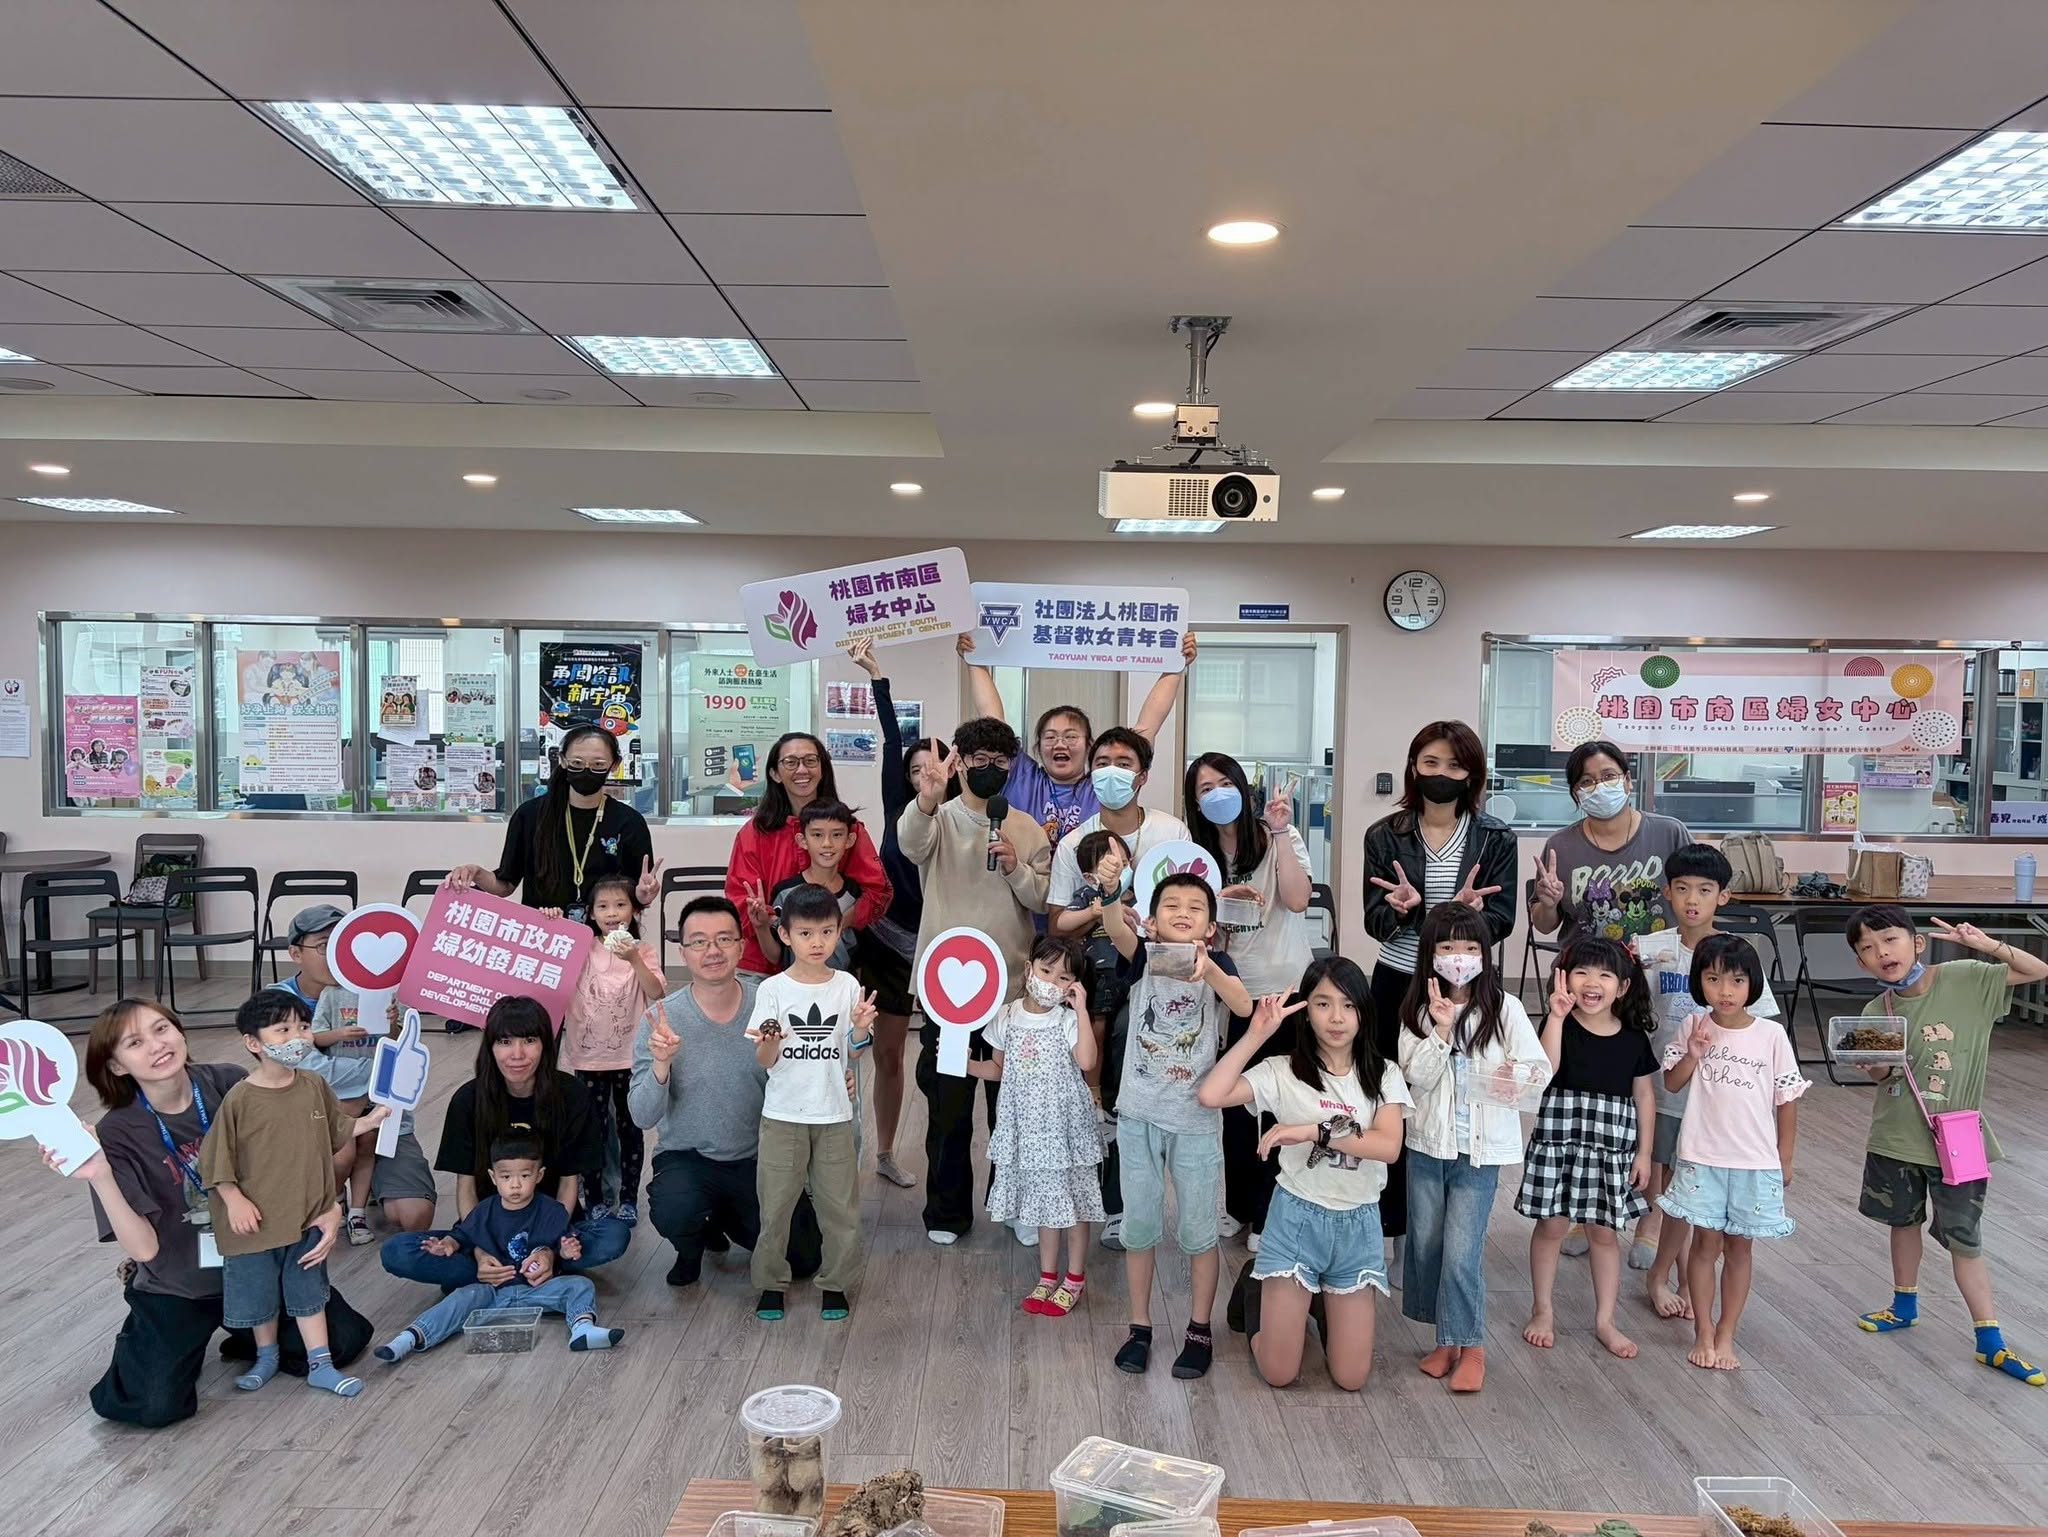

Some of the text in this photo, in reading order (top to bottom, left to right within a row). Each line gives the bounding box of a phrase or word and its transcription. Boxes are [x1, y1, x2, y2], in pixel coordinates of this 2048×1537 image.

[829, 562, 941, 601] 桃園市南區
[1409, 578, 1423, 588] 12
[846, 593, 936, 626] 婦女中心
[1392, 595, 1402, 605] 9
[1427, 596, 1438, 606] 3
[984, 617, 1016, 626] YWCA
[1035, 600, 1179, 623] 社團法人桃園市
[847, 616, 938, 638] TAOYUAN CITY SOUTH
[919, 621, 952, 633] CENTER
[1033, 625, 1179, 648] 基督教女青年會
[1049, 653, 1163, 664] TAOYUAN YWCA OF TAIWAN
[552, 663, 631, 687] 勇闖資訊
[704, 668, 733, 676] 外來人士
[748, 669, 777, 678] 在臺生活
[568, 683, 631, 706] 新宇宙
[704, 695, 746, 710] 1990
[1596, 695, 1918, 722] 桃園市南區婦女中心
[444, 900, 576, 960] 桃園市政府
[432, 930, 563, 990] 婦幼發展局
[427, 970, 493, 997] DEPARTMENT
[420, 988, 491, 1016] DEVELOPMENT
[446, 986, 497, 1007] AND CHIL
[782, 1044, 840, 1060] adidas
